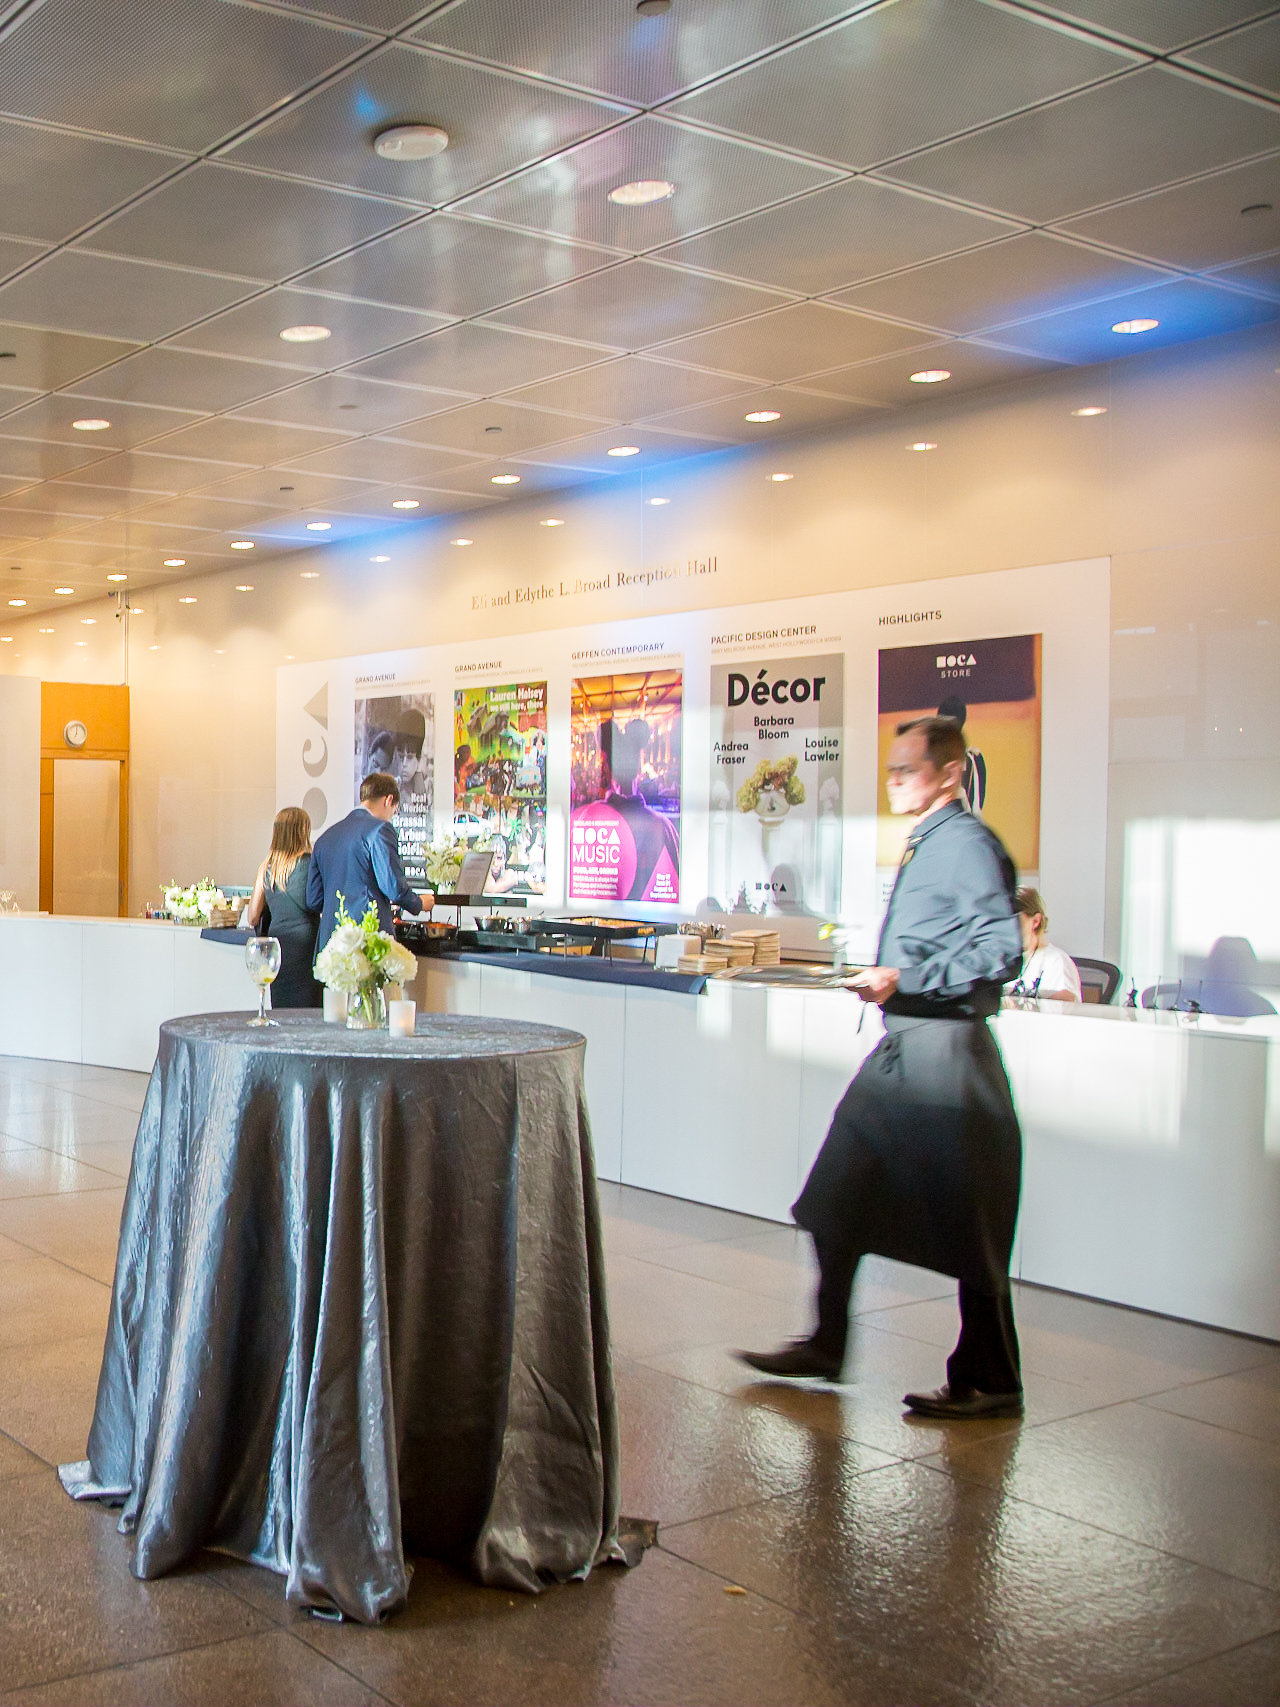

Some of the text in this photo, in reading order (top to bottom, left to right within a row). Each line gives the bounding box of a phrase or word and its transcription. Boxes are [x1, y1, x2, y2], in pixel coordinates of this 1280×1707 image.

[491, 591, 510, 607] and
[515, 584, 554, 604] Edythe
[574, 574, 610, 594] Broad
[617, 566, 681, 586] Reception
[688, 556, 717, 576] Hall
[878, 610, 942, 626] HIGHLIGHTS
[711, 626, 817, 645] PACIFIC DESIGN CENTER
[571, 650, 599, 661] GEFFEN
[600, 642, 665, 657] CONTEMPORARY
[454, 664, 477, 673] GRAND
[478, 660, 502, 670] AVENUE
[936, 654, 977, 668] MOCA
[354, 673, 396, 684] GRAND AVENUE
[941, 669, 971, 679] STORE
[728, 668, 826, 707] Décor
[490, 688, 543, 702] Lauren Halsey
[754, 716, 794, 727] Barbara
[758, 730, 789, 740] Bloom
[714, 741, 749, 752] Andrea
[806, 736, 839, 748] Louise
[302, 681, 328, 831] OCA
[716, 754, 746, 765] Fraser
[805, 750, 840, 762] Lawler
[411, 792, 427, 803] Real
[573, 828, 620, 844] MOCA
[573, 845, 620, 864] MUSIC
[756, 882, 787, 892] MOCA
